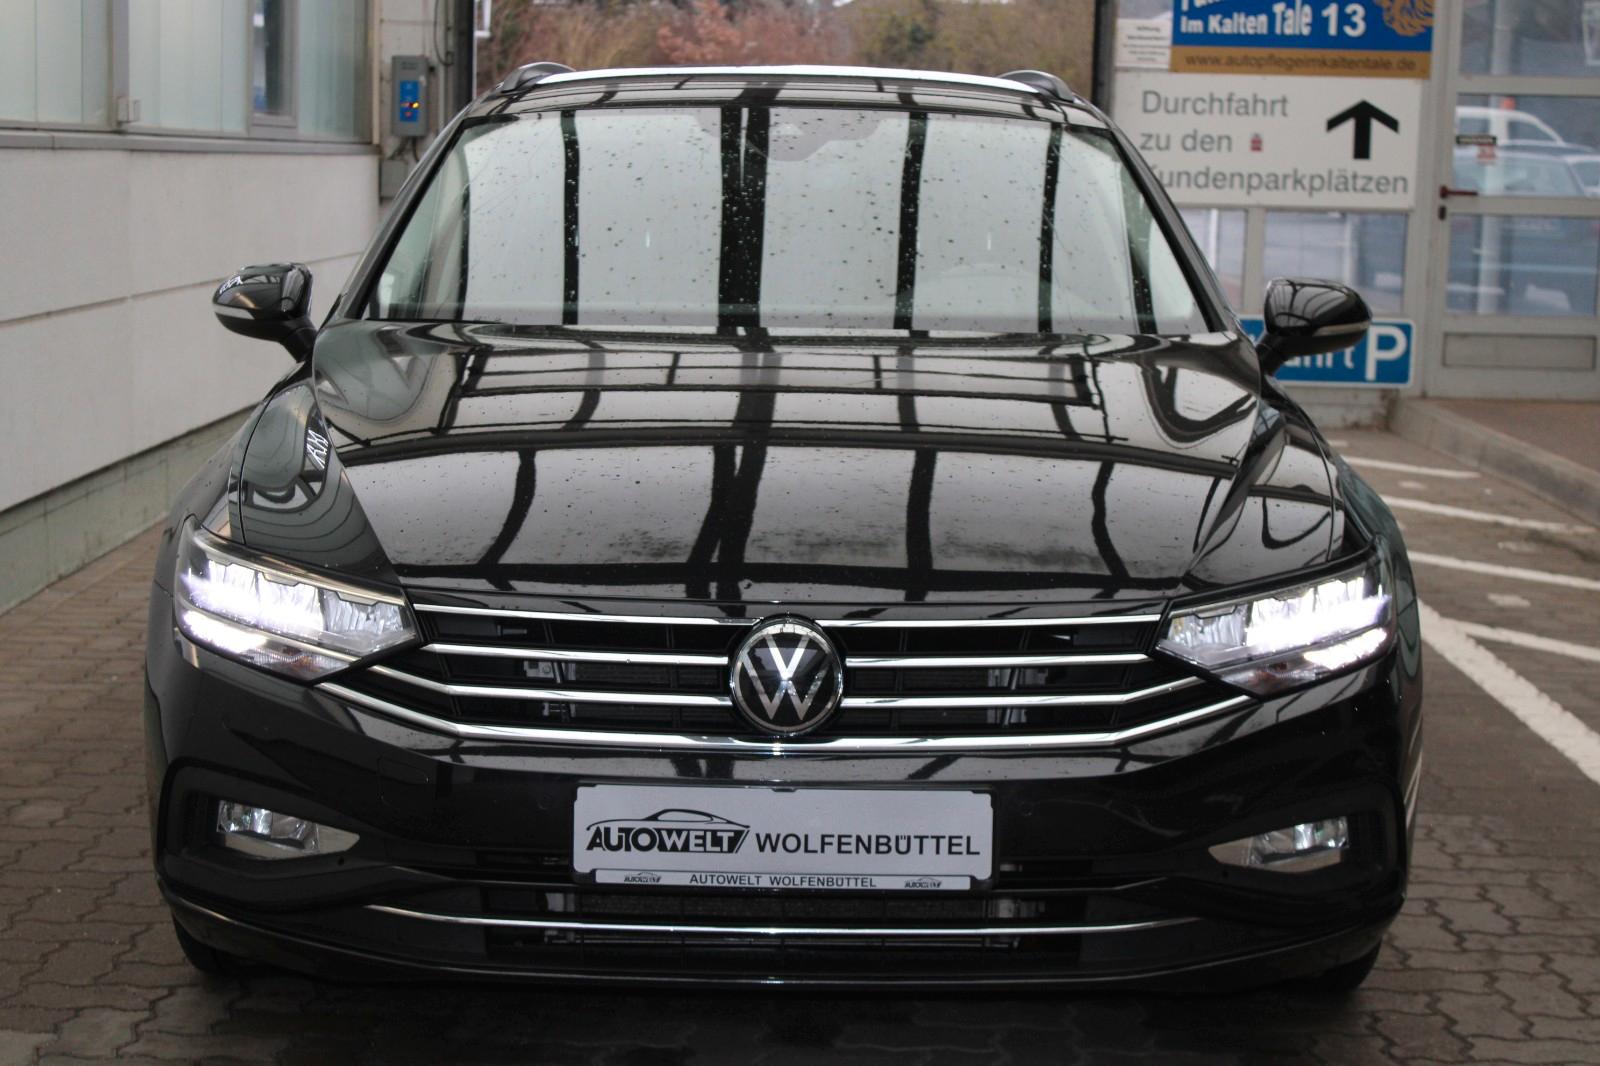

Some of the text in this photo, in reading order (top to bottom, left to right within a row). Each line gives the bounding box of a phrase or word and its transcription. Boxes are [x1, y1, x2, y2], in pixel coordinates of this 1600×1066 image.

[1180, 0, 1367, 37] Im Kalten Tale 13
[1142, 89, 1289, 117] Durchfahrt
[1139, 129, 1233, 152] zu den
[1150, 164, 1409, 197] undenparkplätzen
[1365, 325, 1407, 381] P
[586, 826, 981, 856] AUTOWELT WOLFENBÜTTEL
[689, 874, 877, 888] AUTOWELT WOLFENBÜTTEL
